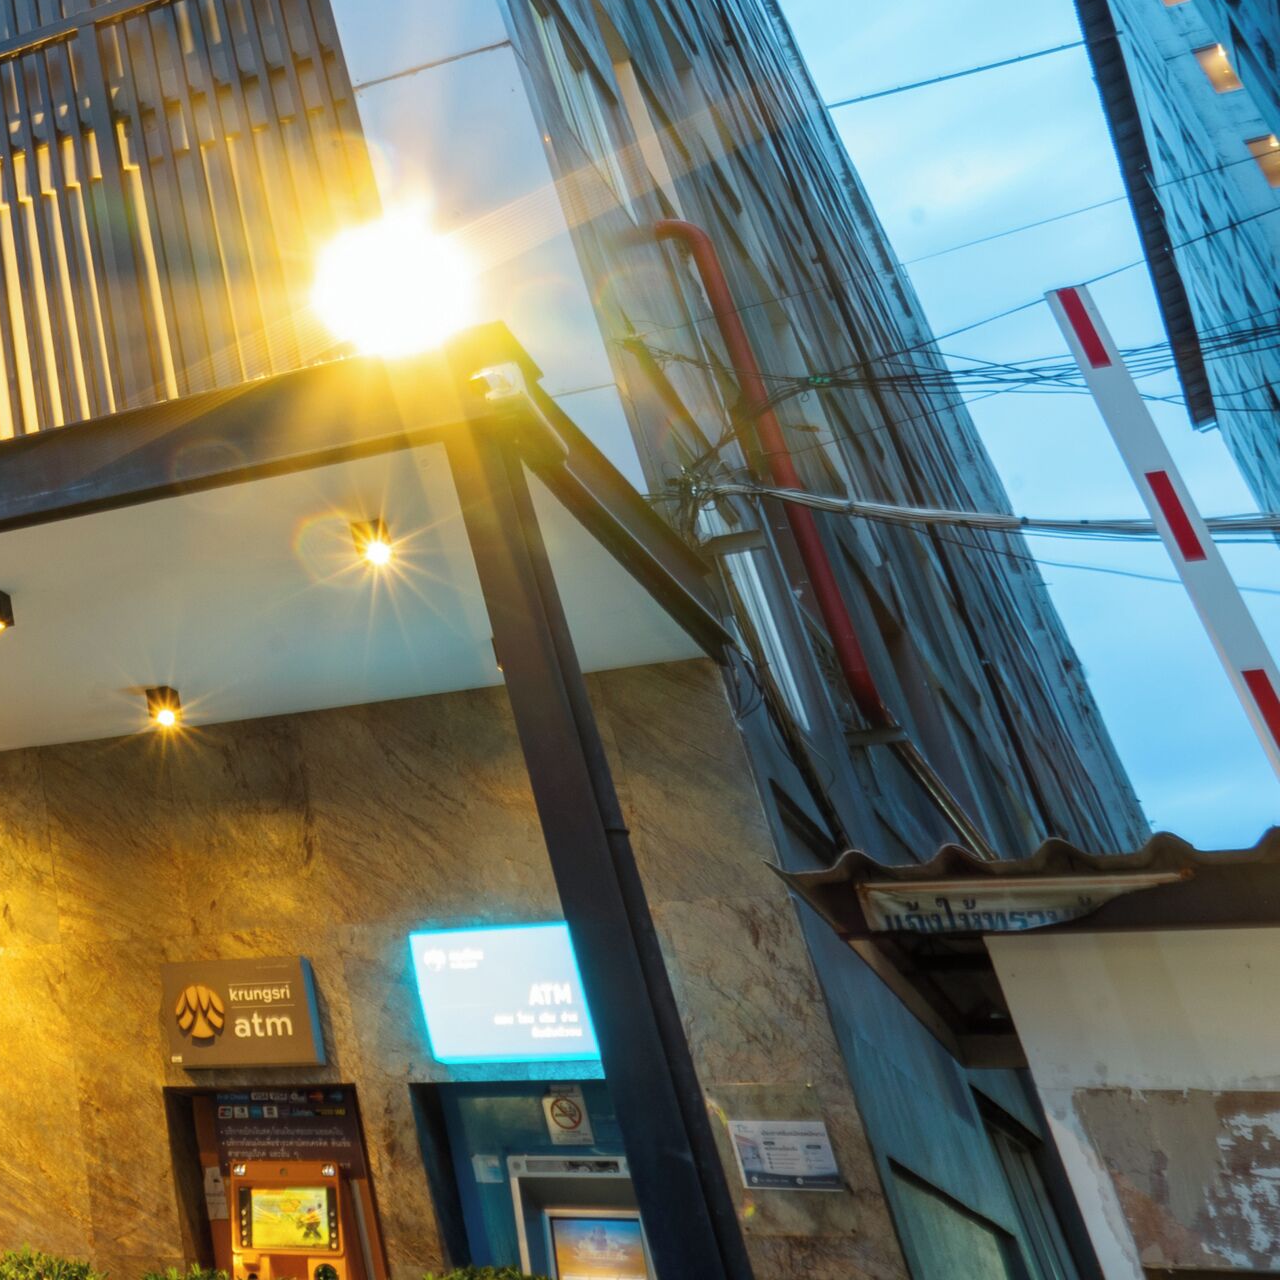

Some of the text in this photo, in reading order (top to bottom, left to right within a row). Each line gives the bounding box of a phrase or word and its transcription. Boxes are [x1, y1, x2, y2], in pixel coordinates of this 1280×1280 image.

[228, 984, 290, 1003] krungsri
[528, 981, 573, 1006] ATM
[234, 1011, 293, 1038] atm
